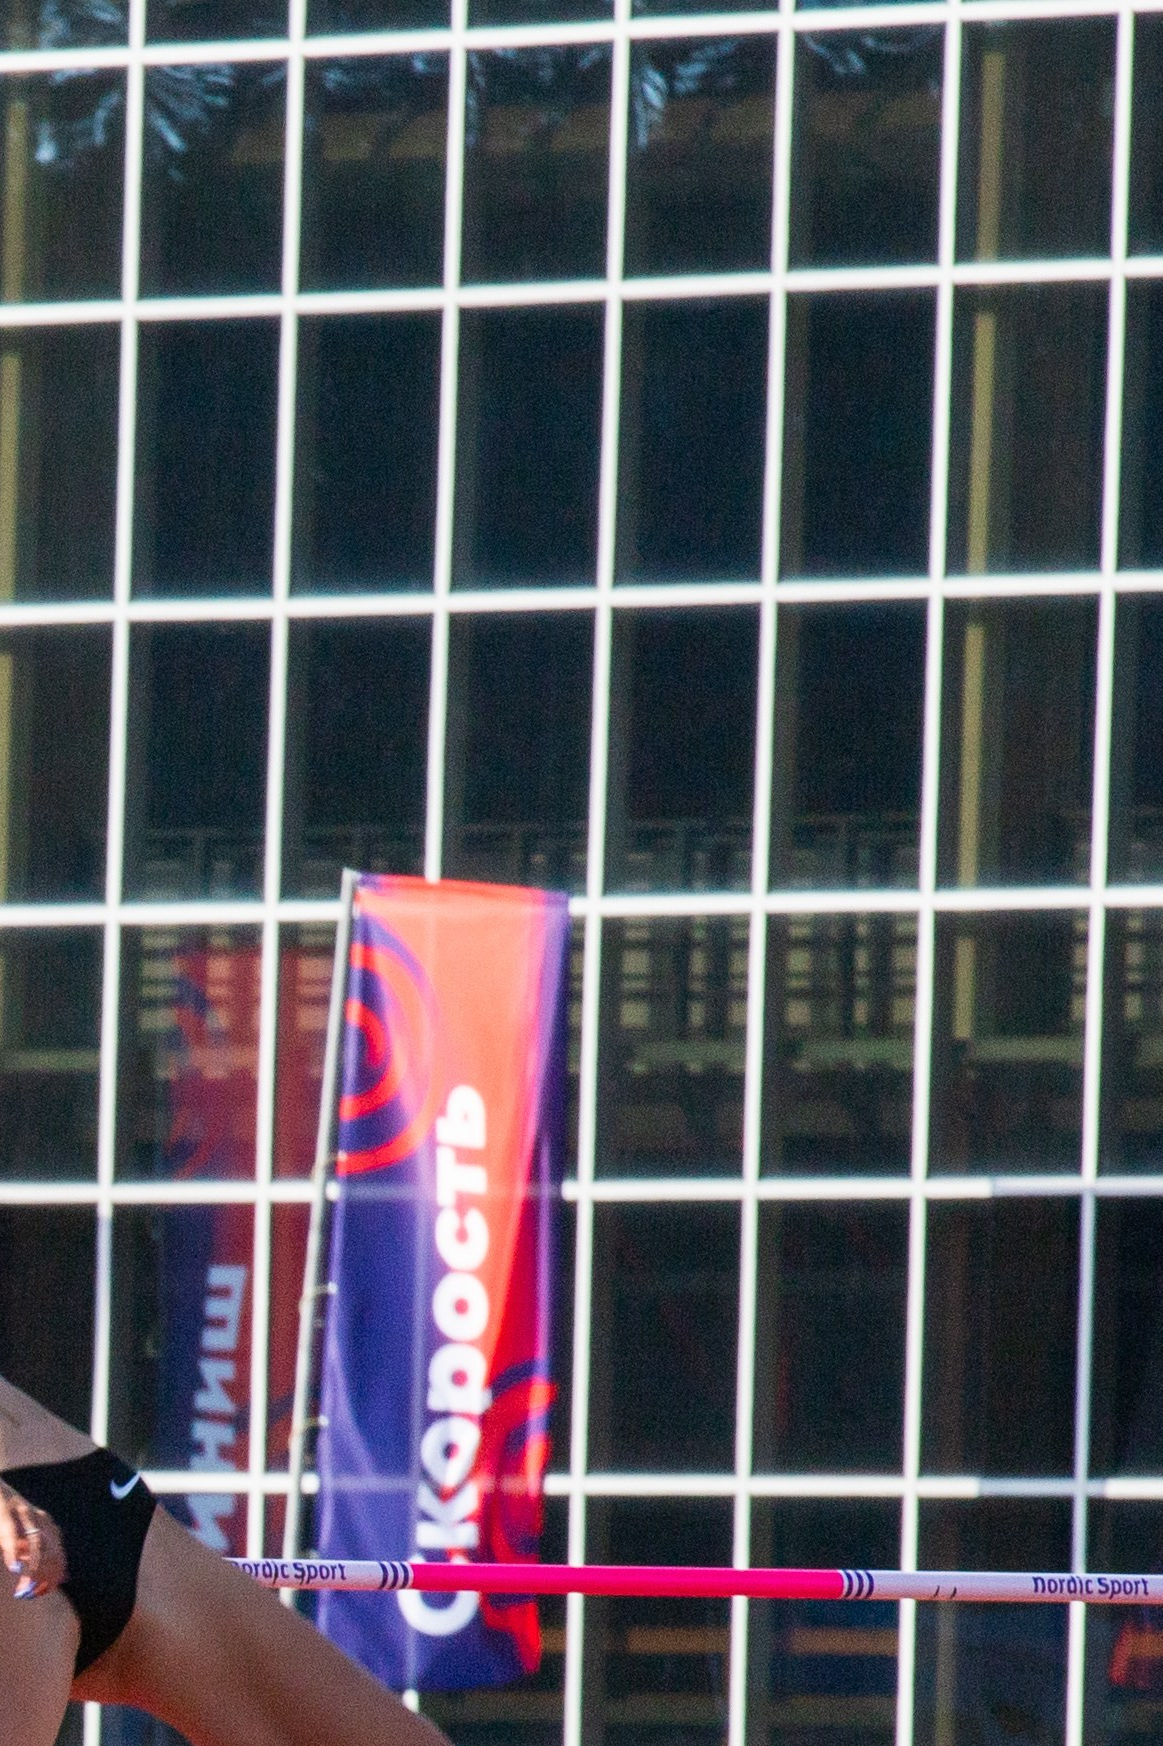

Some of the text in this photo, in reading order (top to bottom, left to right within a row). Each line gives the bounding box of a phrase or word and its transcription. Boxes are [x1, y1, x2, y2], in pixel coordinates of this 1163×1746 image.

[396, 1084, 492, 1637] Скорость
[292, 1562, 347, 1584] Sport
[1097, 1576, 1150, 1600] Sport
